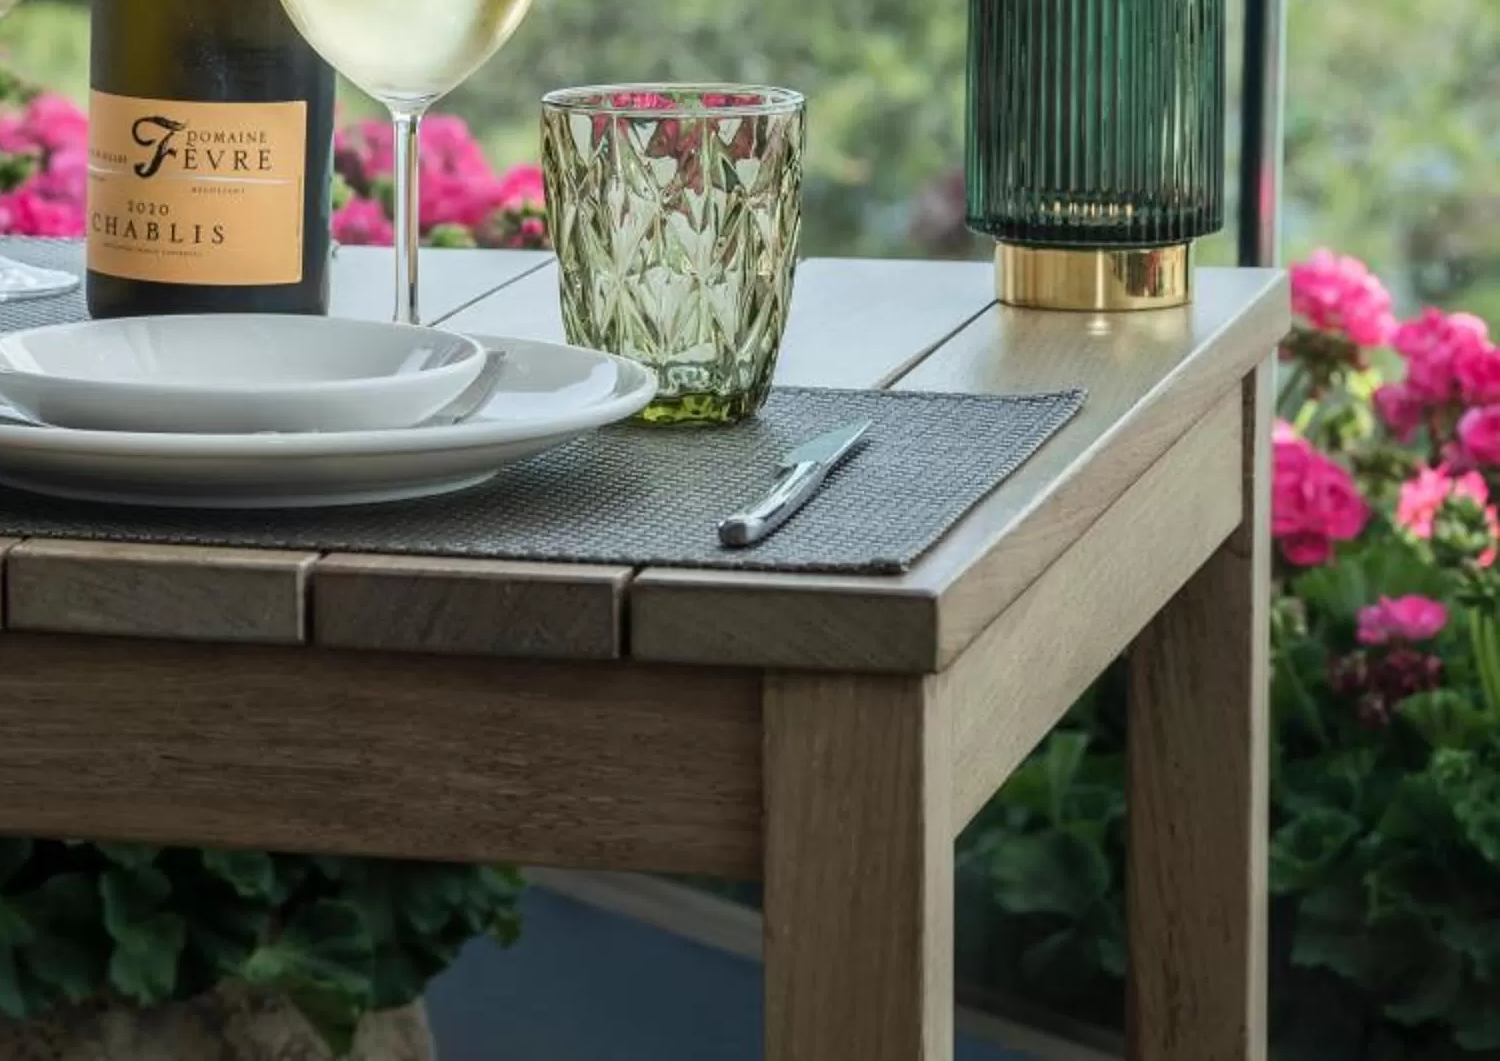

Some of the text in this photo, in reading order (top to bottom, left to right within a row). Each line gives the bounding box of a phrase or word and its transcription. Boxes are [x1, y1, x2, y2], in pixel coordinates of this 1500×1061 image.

[131, 115, 274, 179] FÈVRE
[186, 129, 268, 146] DOMAINE
[126, 199, 171, 216] 2020
[91, 212, 227, 245] CHABLIS
